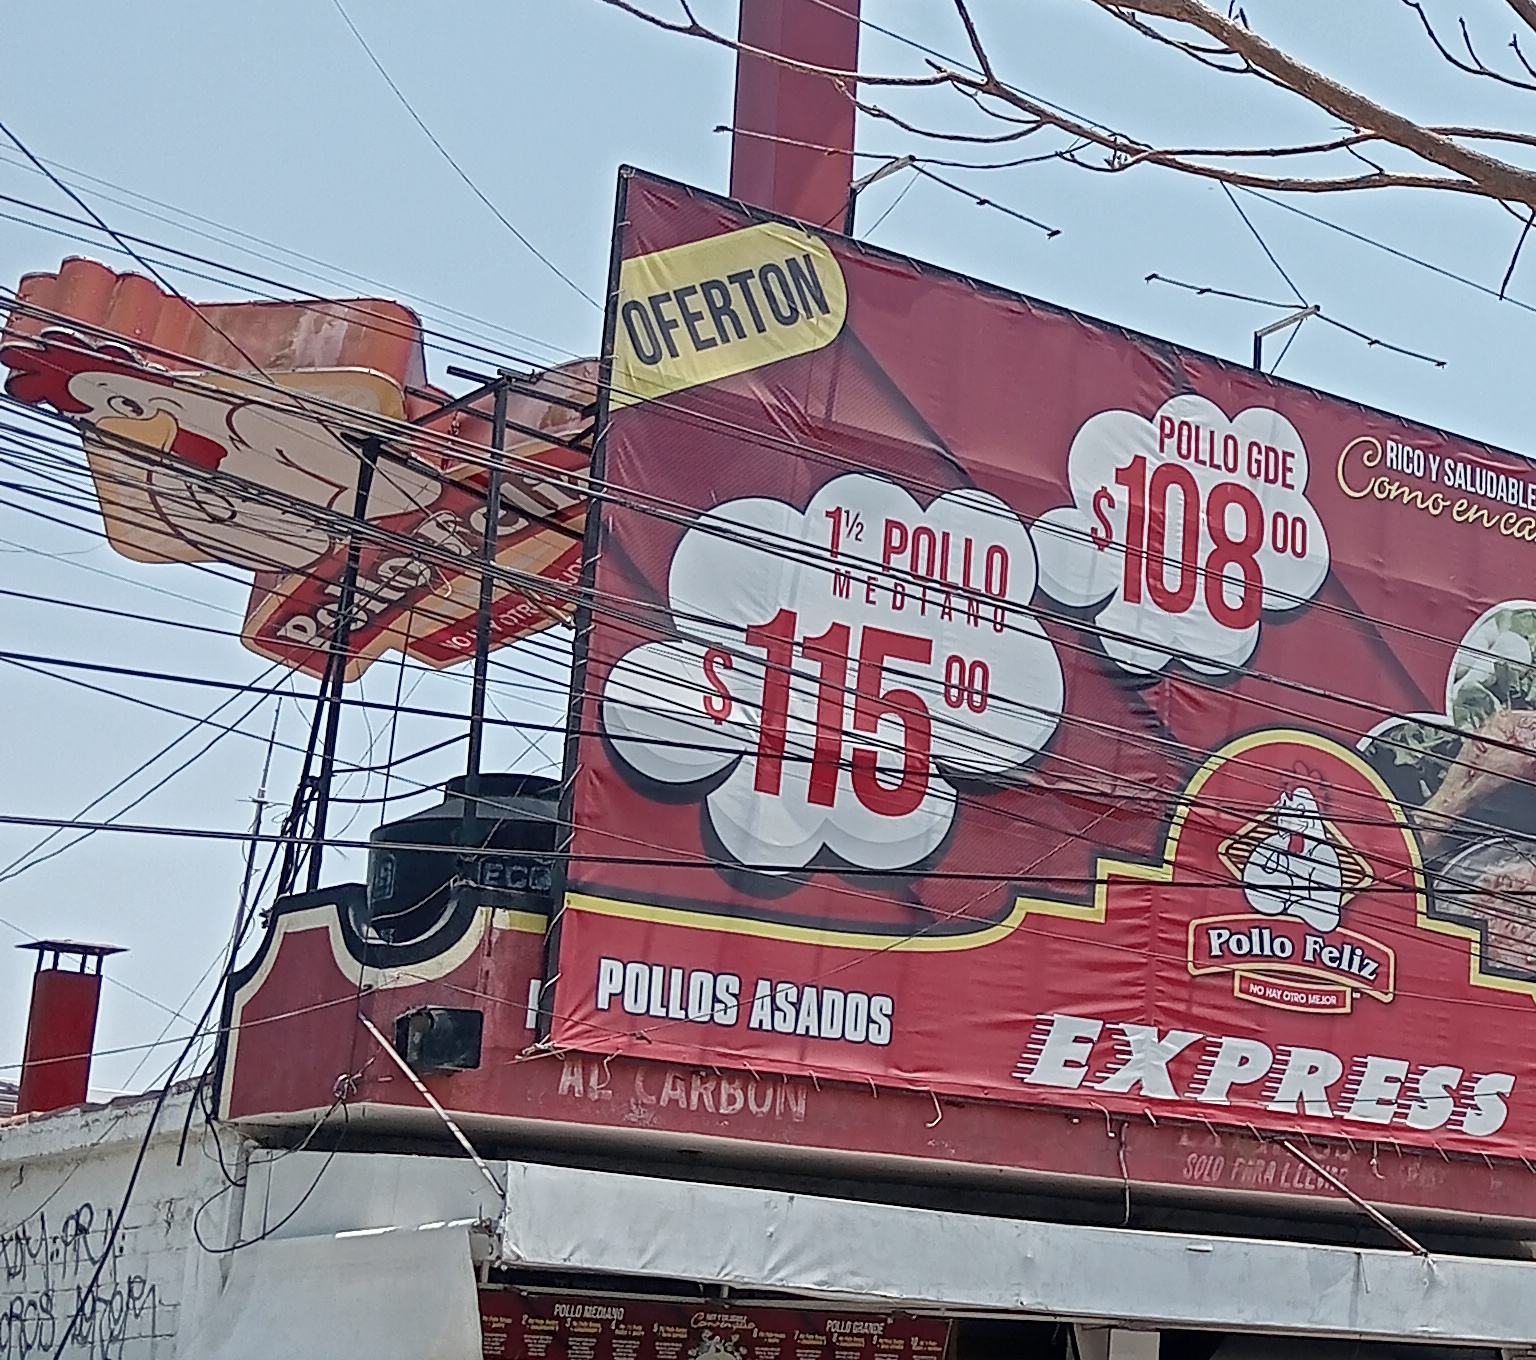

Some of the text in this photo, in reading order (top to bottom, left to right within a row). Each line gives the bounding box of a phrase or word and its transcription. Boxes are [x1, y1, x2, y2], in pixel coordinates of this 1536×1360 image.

[621, 253, 831, 367] OFERTON
[1158, 415, 1296, 492] POLLO GDE
[1337, 436, 1451, 516] Como
[1452, 497, 1500, 529] en
[1385, 440, 1425, 478] RICO
[1428, 452, 1442, 483] Y
[884, 517, 1010, 599] POLLO
[832, 566, 1006, 634] MEDIANO
[1207, 926, 1380, 982] Pollo Feliz
[595, 956, 742, 1027] POLLOS
[748, 978, 895, 1047] ASADOS
[1249, 982, 1263, 996] NO
[1265, 987, 1282, 1001] HAY
[1283, 991, 1307, 1005] OTRO
[1308, 993, 1337, 1006] MEJOR
[558, 1058, 613, 1103] AL
[1014, 1013, 1516, 1138] EXPRESS
